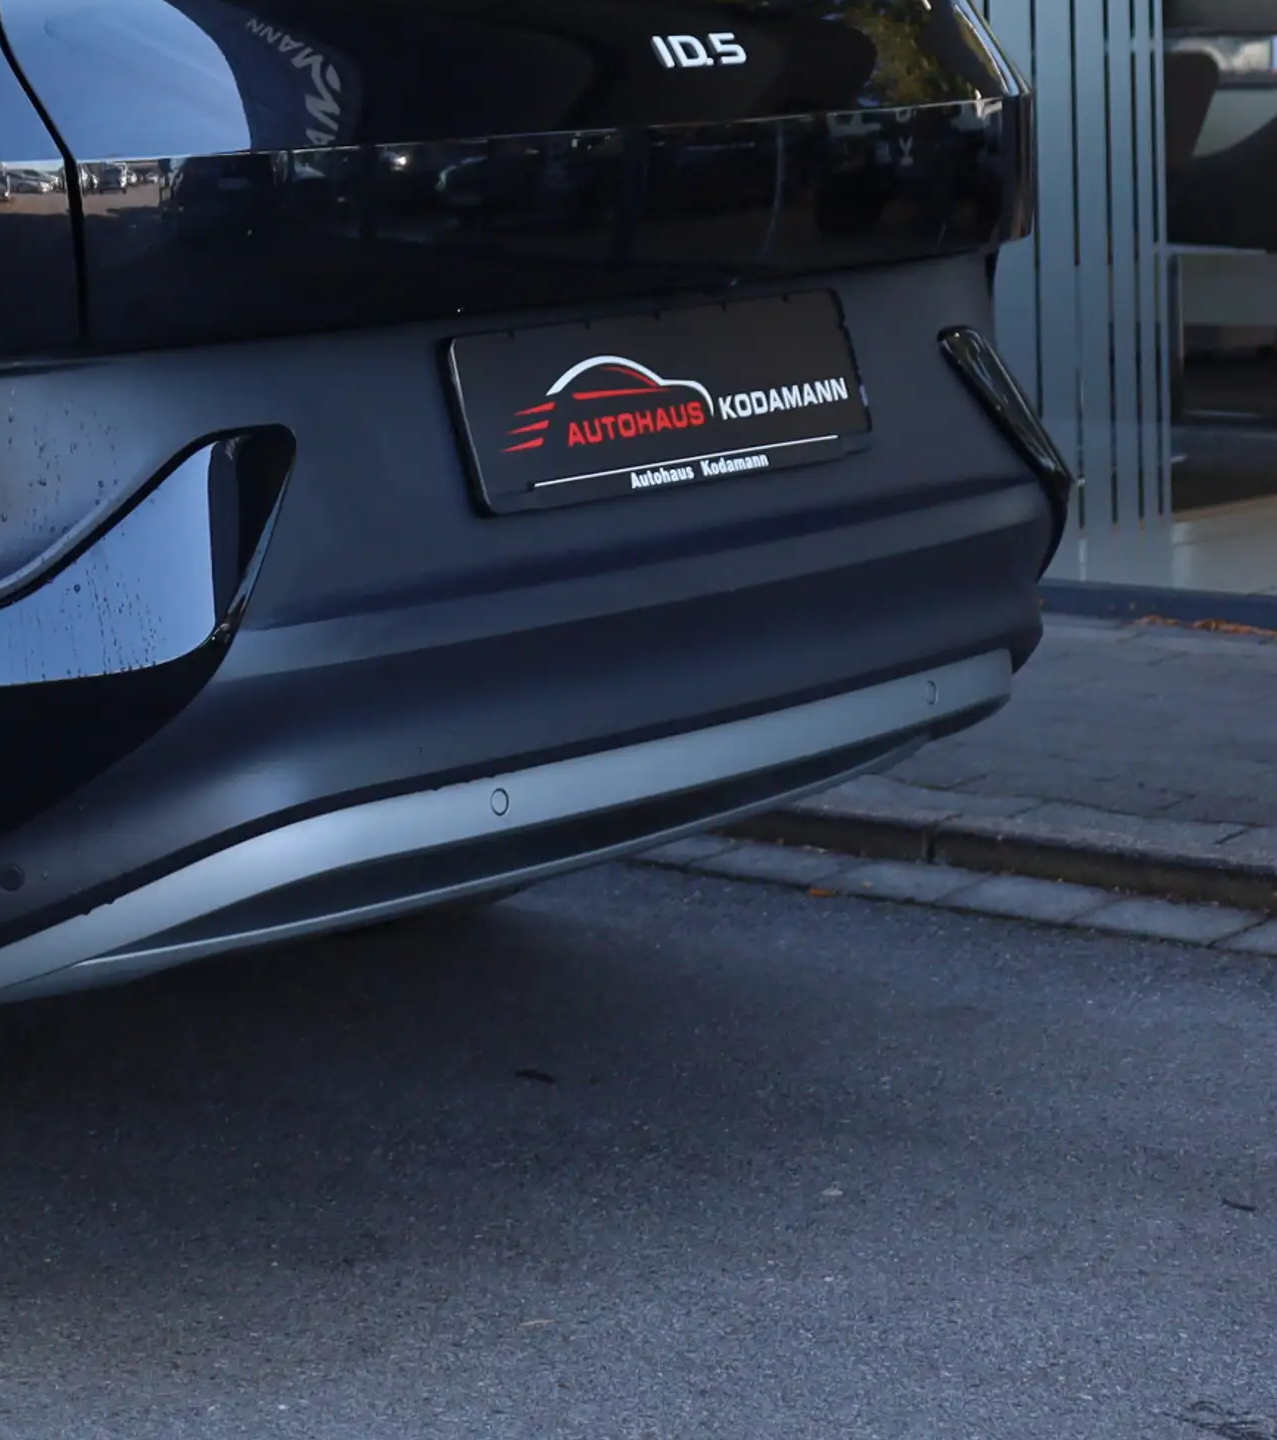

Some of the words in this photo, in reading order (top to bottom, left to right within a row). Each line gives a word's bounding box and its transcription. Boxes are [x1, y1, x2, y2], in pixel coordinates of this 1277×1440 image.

[567, 401, 705, 447] AUTOHAUS
[718, 376, 849, 421] KODAMANN
[631, 465, 695, 490] Autohaus
[700, 454, 769, 477] Kodamann
